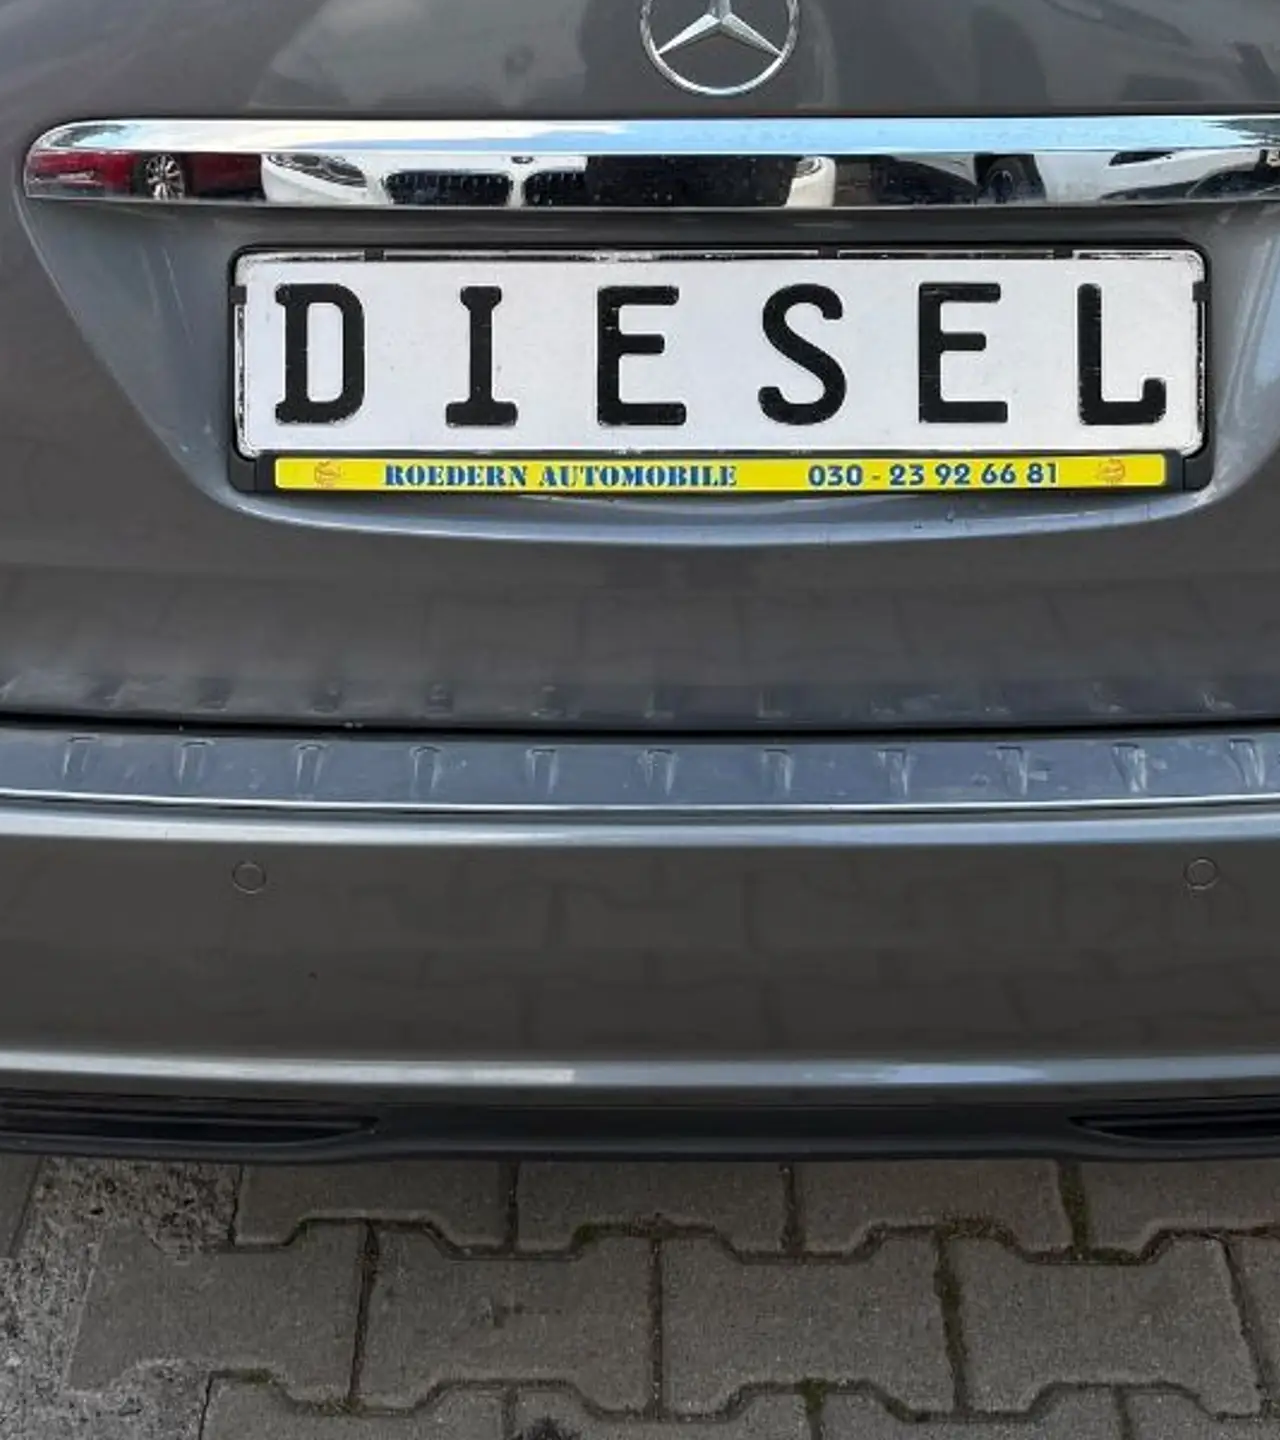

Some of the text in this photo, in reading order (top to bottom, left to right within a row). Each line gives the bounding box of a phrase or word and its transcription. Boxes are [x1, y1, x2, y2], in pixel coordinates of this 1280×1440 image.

[274, 282, 1168, 428] DIESEL
[383, 464, 528, 488] ROEDERN
[538, 463, 737, 488] AUTOMOBILE
[808, 464, 863, 487] 030
[889, 464, 925, 487] 23
[934, 463, 971, 486] 92
[980, 463, 1017, 485] 66
[1026, 462, 1058, 485] 81
